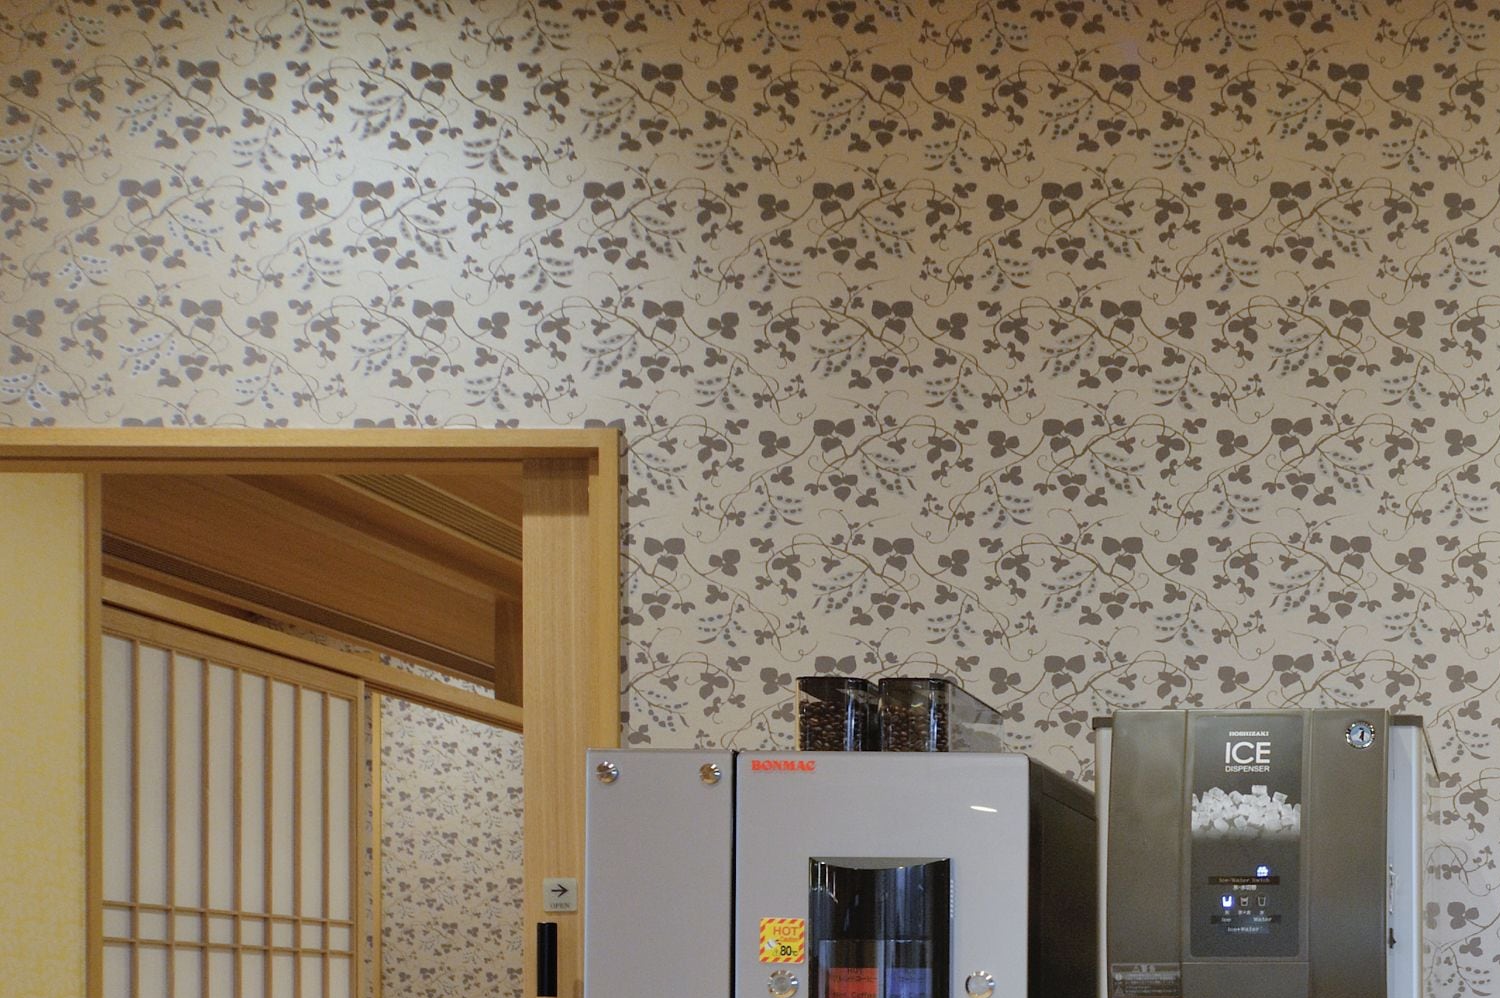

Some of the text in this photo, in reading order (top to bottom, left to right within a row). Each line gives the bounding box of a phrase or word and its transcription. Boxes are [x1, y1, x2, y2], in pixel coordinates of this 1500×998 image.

[1225, 742, 1271, 764] ICE
[751, 760, 816, 771] BONMAC
[772, 926, 799, 936] HOT
